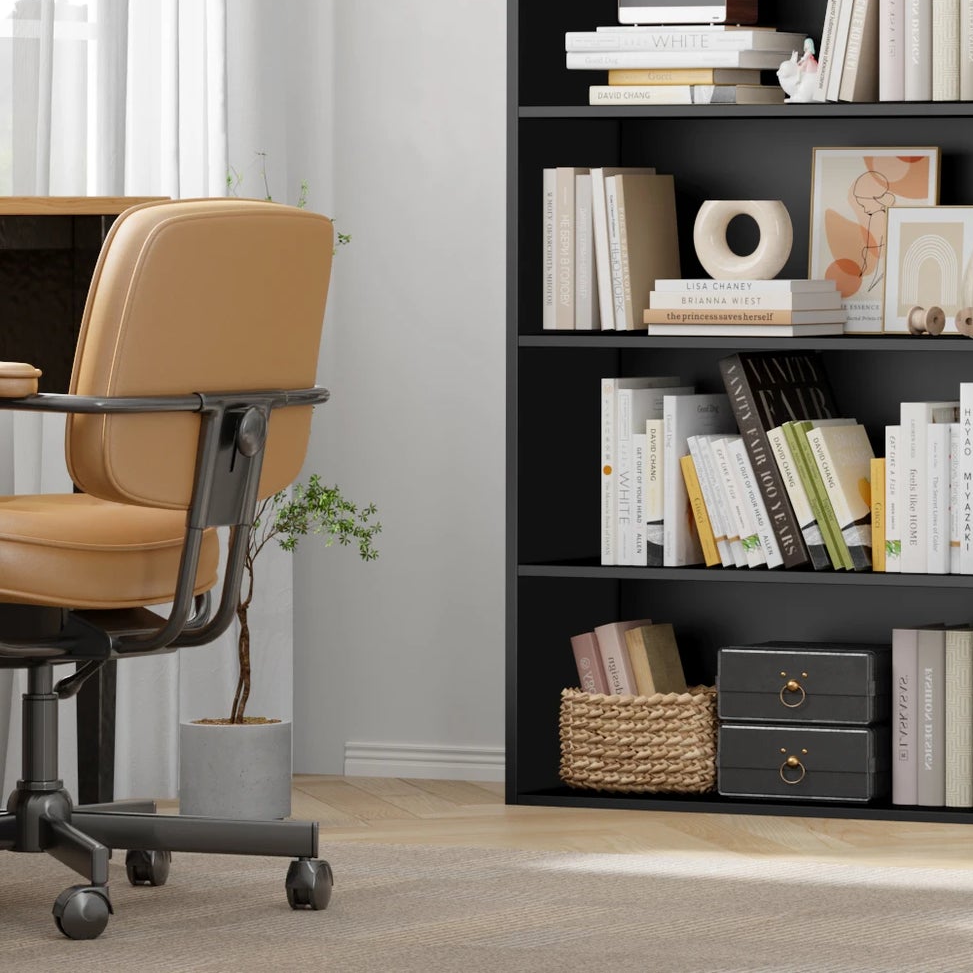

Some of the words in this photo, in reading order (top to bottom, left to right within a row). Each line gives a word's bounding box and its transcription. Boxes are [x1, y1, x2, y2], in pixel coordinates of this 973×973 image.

[651, 33, 710, 49] WHITE
[597, 91, 622, 100] DAVID
[622, 90, 651, 99] CHANG
[686, 282, 708, 291] LISA
[712, 282, 753, 291] CHANEY
[681, 296, 728, 306] BRIANNA
[731, 296, 762, 306] WIEST
[649, 427, 657, 453] DAVID
[964, 407, 972, 457] HAYAO
[649, 454, 657, 482] CHANG
[727, 364, 754, 424] VANITY
[746, 426, 767, 467] FAIR
[759, 469, 777, 499] 100
[771, 504, 798, 557] YEARS
[772, 436, 786, 462] DAVID
[782, 461, 796, 488] CHANG
[812, 437, 826, 462] DAVID
[822, 461, 835, 490] CHANG
[908, 468, 918, 492] feels
[932, 476, 940, 488] The
[618, 470, 631, 525] WHITE
[908, 493, 918, 513] like
[873, 501, 881, 530] Gucci
[963, 471, 972, 552] MIYAZAKI
[908, 514, 918, 547] HOME
[932, 526, 940, 535] of
[932, 534, 940, 552] Color
